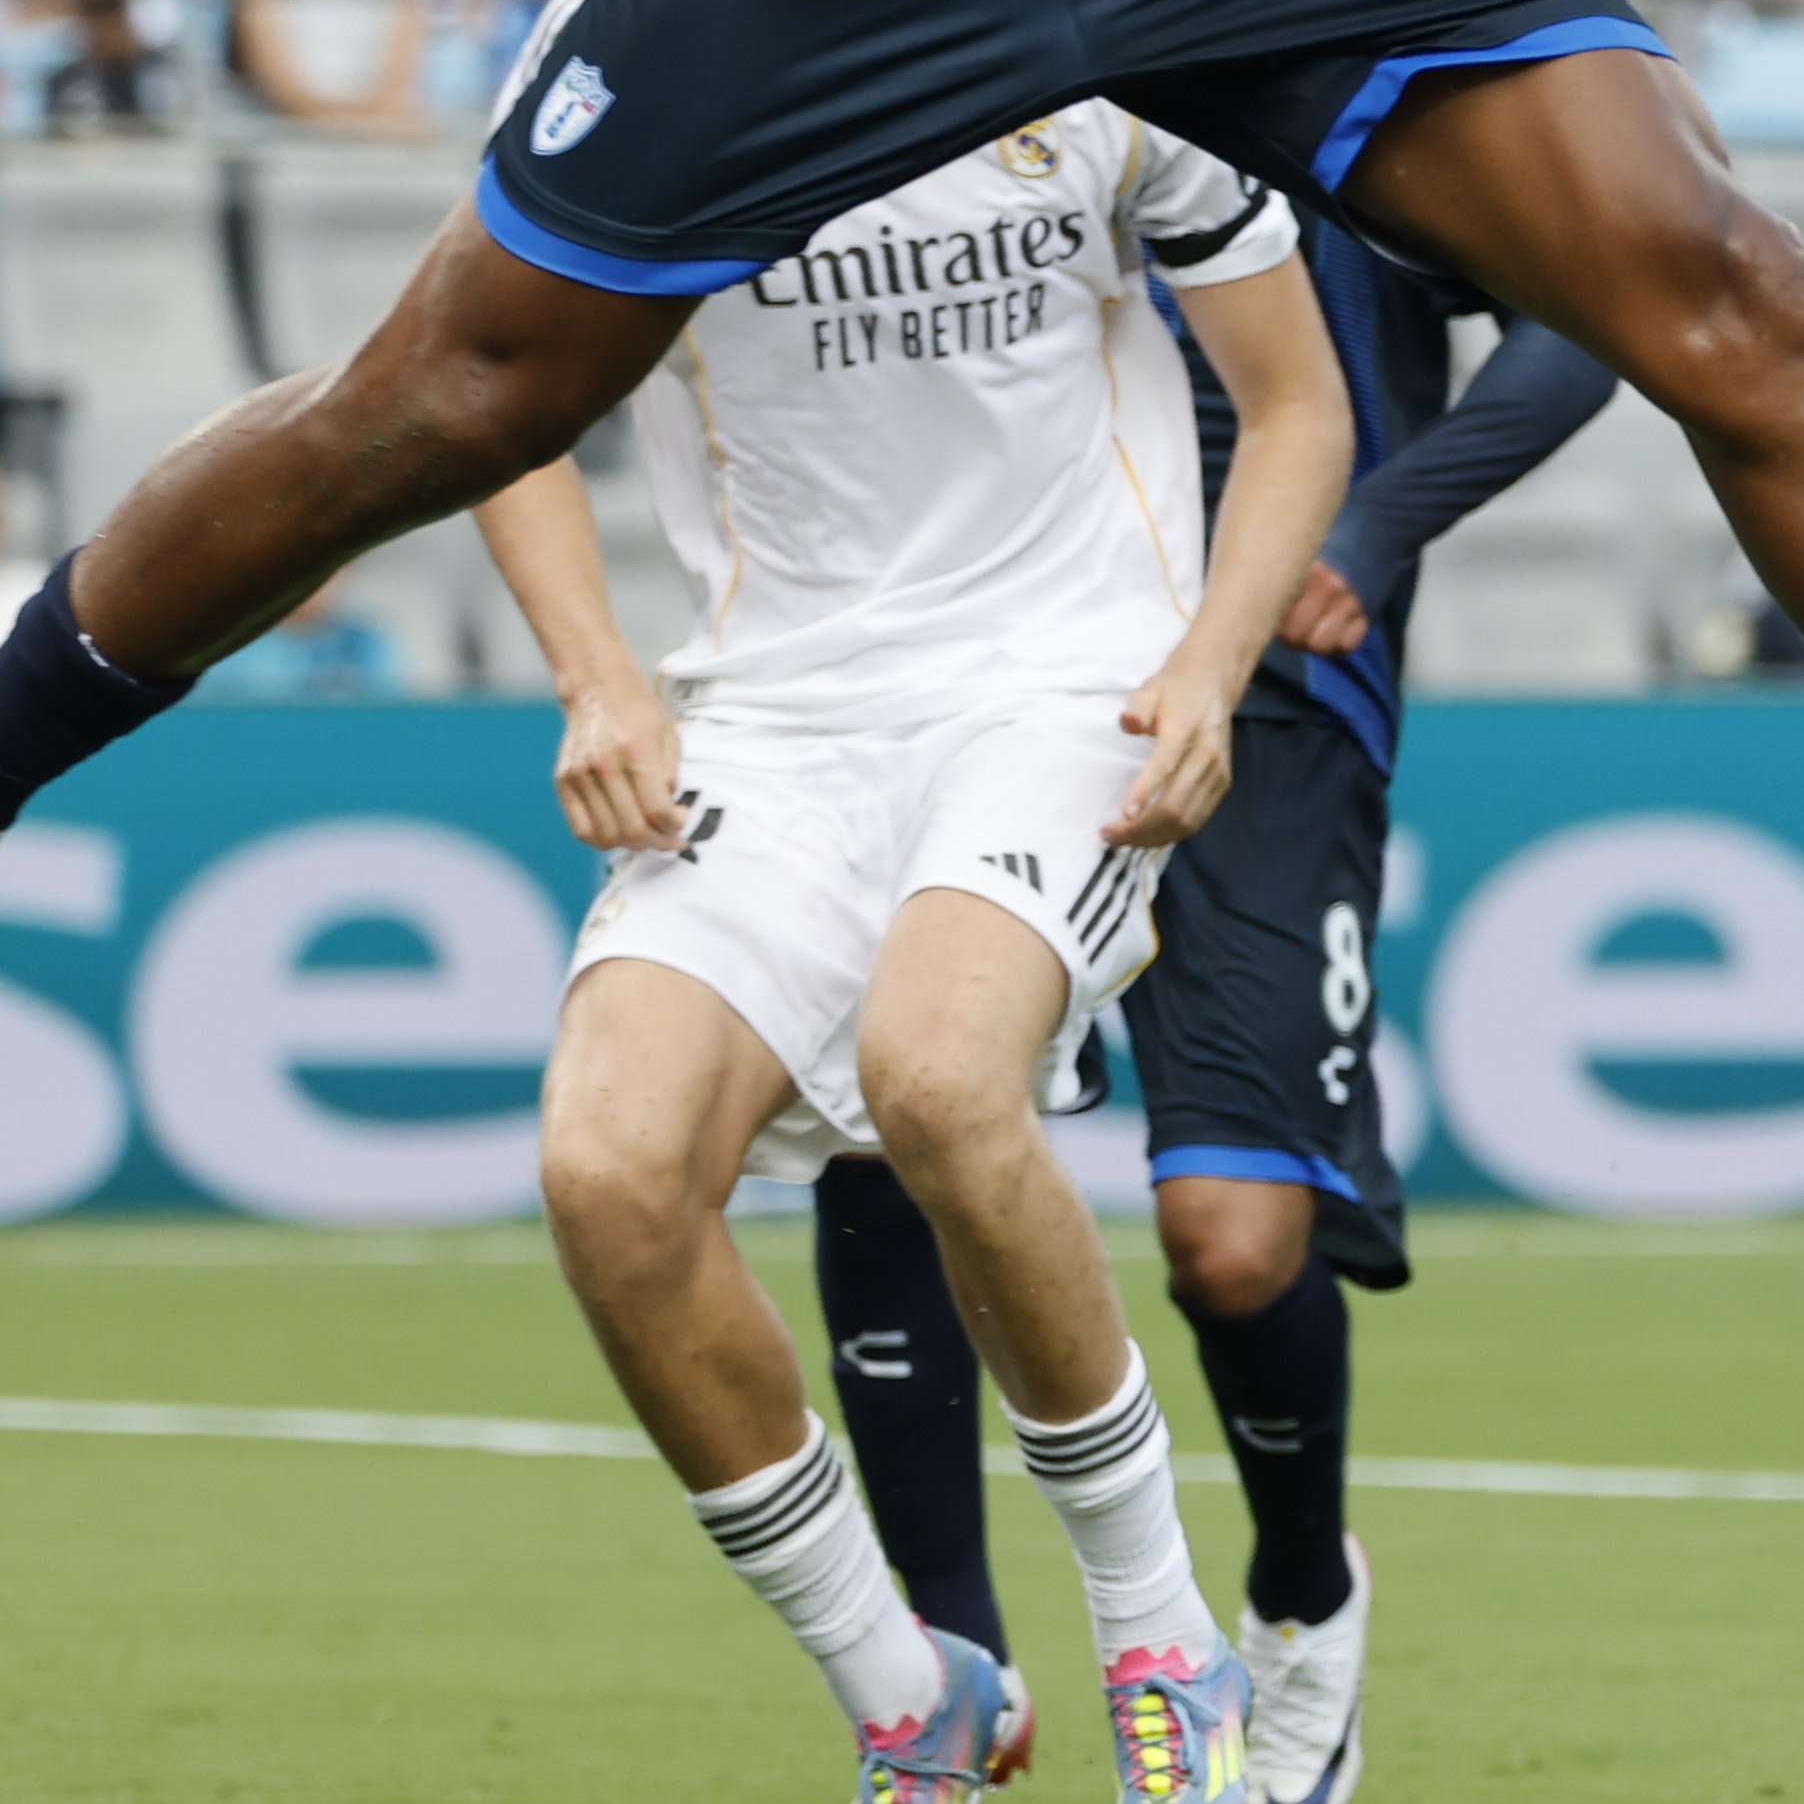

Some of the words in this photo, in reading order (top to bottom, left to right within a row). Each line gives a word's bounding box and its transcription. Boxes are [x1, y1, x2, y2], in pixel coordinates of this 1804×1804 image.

[812, 314, 879, 372] FLY
[901, 282, 1045, 360] BETTER
[1322, 900, 1370, 1037] 8
